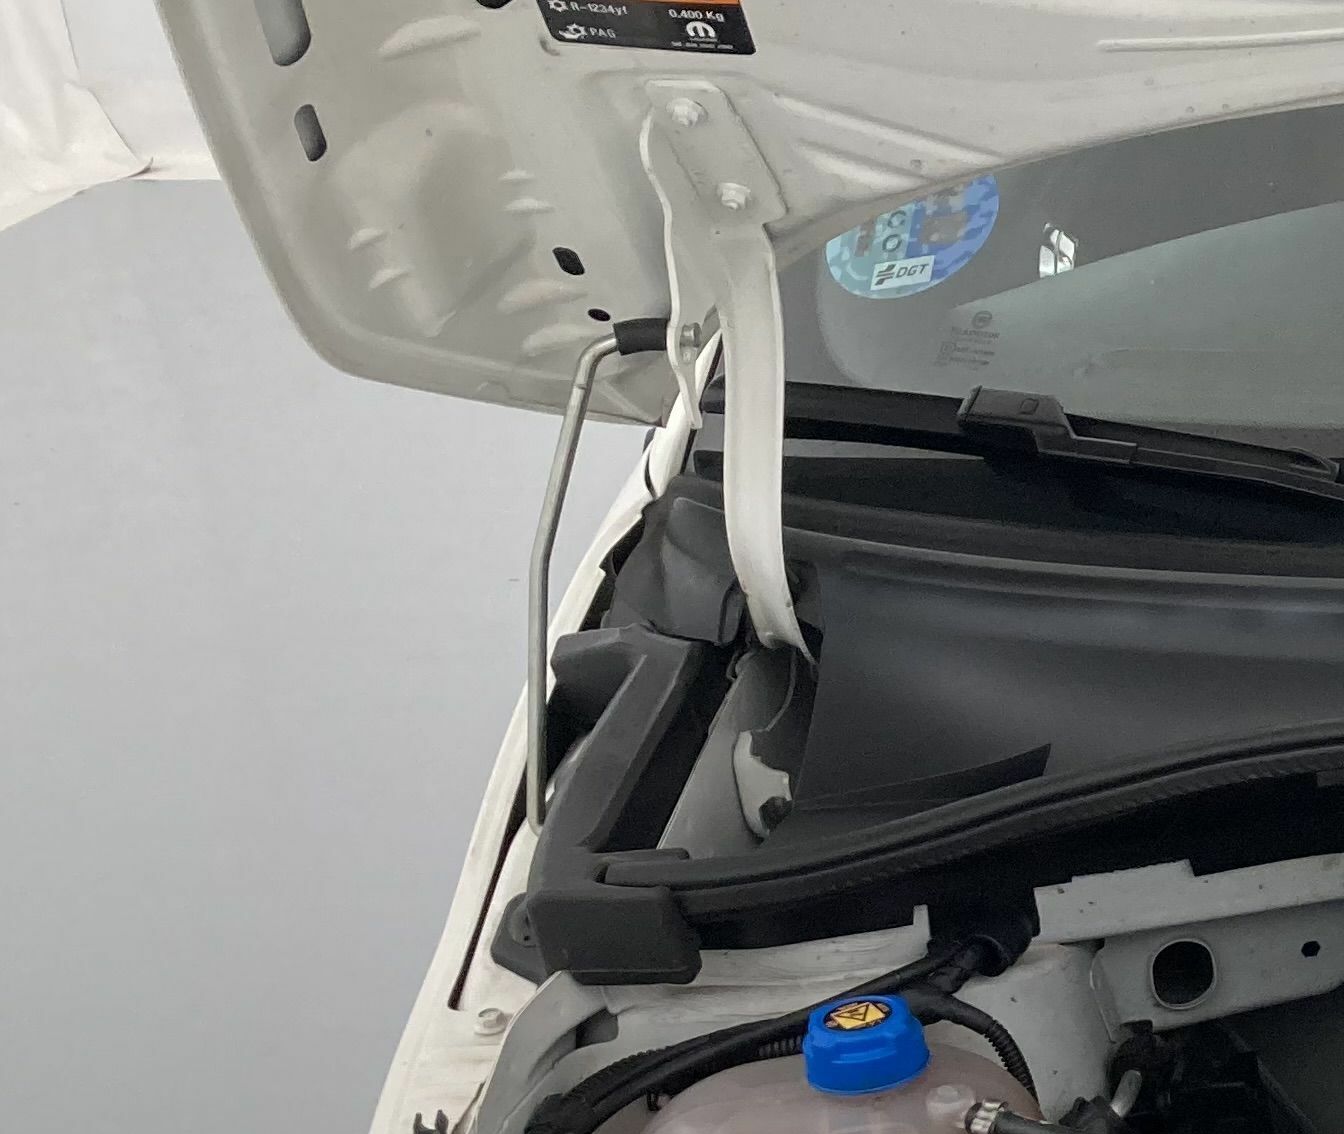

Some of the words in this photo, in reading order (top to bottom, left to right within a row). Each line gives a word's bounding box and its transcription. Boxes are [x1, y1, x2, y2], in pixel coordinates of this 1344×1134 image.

[705, 10, 725, 23] Kg
[590, 27, 617, 39] PAG
[896, 263, 930, 279] DGT
